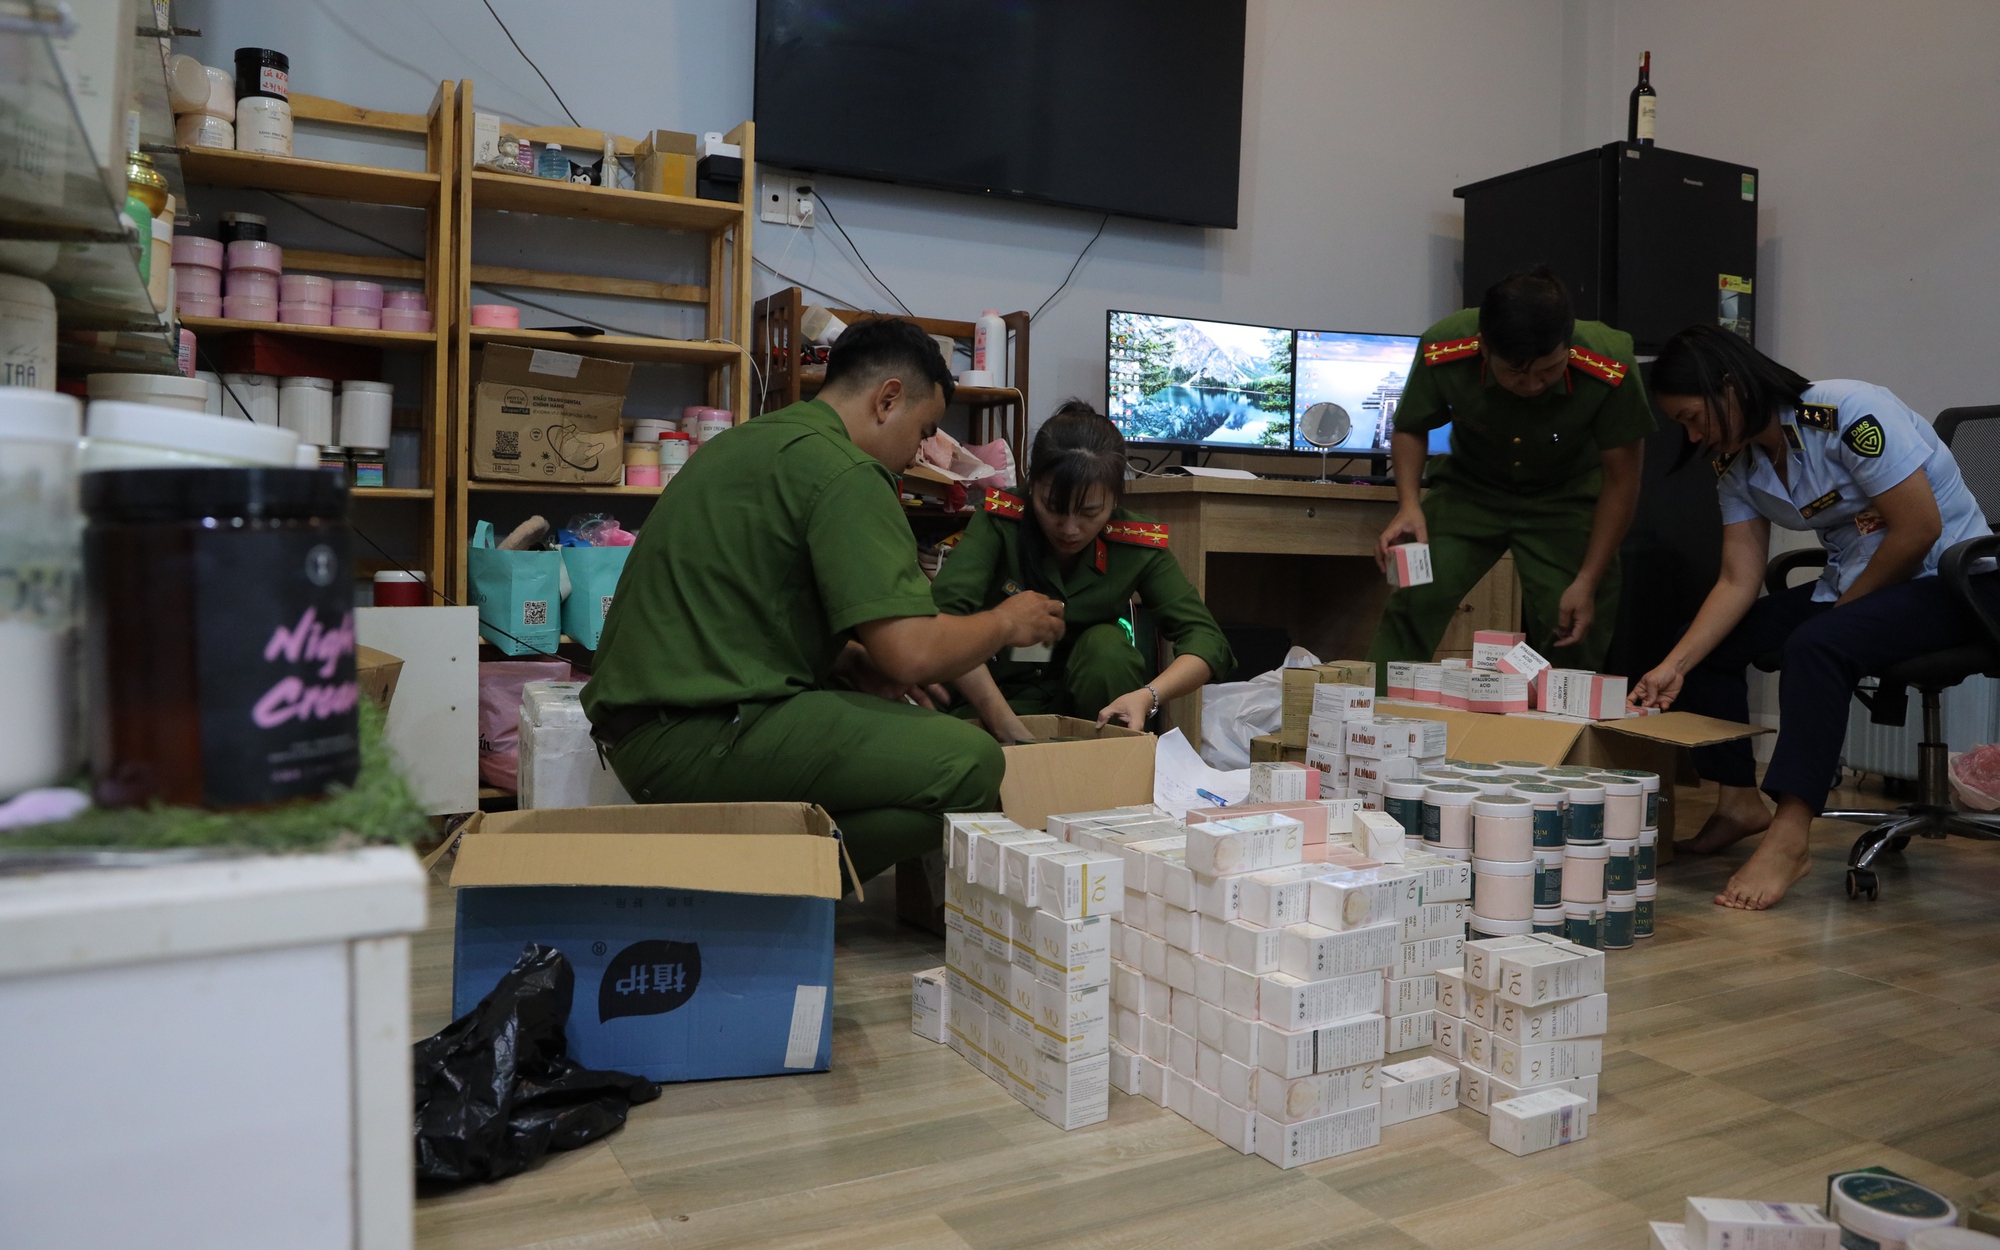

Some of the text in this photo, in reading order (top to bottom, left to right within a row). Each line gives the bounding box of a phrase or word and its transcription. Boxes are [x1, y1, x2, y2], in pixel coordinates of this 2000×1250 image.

[1851, 421, 1870, 437] DMS
[1520, 645, 1544, 665] HYALURONIC
[1522, 654, 1533, 664] ACID
[1350, 698, 1371, 709] ALMOND
[1351, 733, 1376, 746] ALMOND
[1310, 760, 1332, 774] ALMOND
[1354, 767, 1377, 781] ALMOND
[1284, 827, 1298, 851] MQ
[1461, 867, 1469, 884] MQ
[1092, 875, 1106, 903] MQ
[1407, 878, 1417, 900] MQ
[970, 898, 982, 918] MQ
[1456, 903, 1463, 919] MQ
[990, 909, 1003, 930] MQ
[1071, 923, 1084, 933] MQ
[1019, 921, 1032, 943] MQ
[1043, 936, 1059, 959] MQ
[1070, 941, 1089, 953] SUN
[1456, 939, 1464, 955] MQ
[971, 960, 983, 980] MQ
[1472, 955, 1482, 979] MQ
[615, 963, 687, 996] 植护
[993, 973, 1006, 994] MQ
[1509, 972, 1522, 996] MQ
[1538, 979, 1547, 1000] MQ
[1017, 988, 1030, 1010] MQ
[1070, 993, 1083, 1003] MQ
[1443, 982, 1453, 1007] MQ
[1043, 1006, 1059, 1028] MQ
[1070, 1011, 1089, 1023] SUN
[1474, 994, 1485, 1019] MQ
[1502, 1006, 1514, 1032] MQ
[1531, 1017, 1542, 1038] MQ
[1441, 1023, 1452, 1047] MQ
[992, 1037, 1006, 1059] MQ
[1471, 1036, 1482, 1061] MQ
[1015, 1054, 1028, 1076] MQ
[1502, 1048, 1514, 1076] MQ
[1531, 1061, 1542, 1081] MQ
[1362, 1064, 1375, 1090] MQ
[1441, 1076, 1451, 1097] MQ
[1468, 1077, 1479, 1102] MQ
